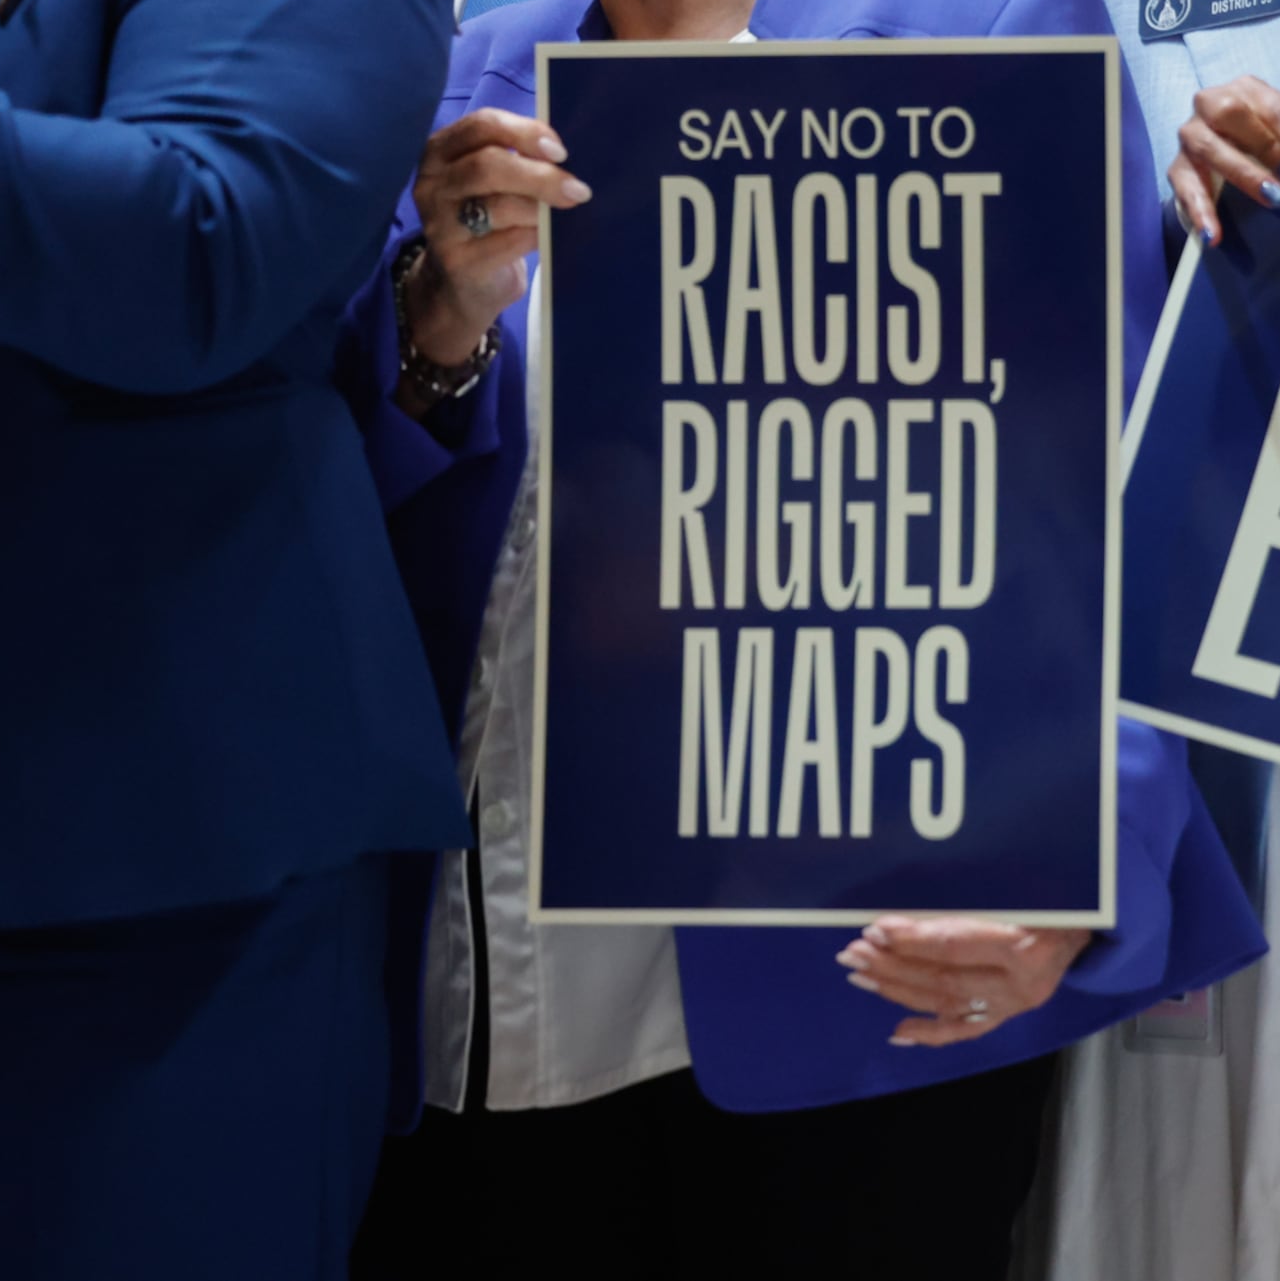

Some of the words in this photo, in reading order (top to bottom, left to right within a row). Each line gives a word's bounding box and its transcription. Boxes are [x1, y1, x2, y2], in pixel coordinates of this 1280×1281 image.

[679, 109, 786, 160] SAY
[802, 108, 884, 159] NO
[897, 107, 975, 158] TO
[660, 172, 1005, 403] RACIST,
[659, 398, 997, 611] RIGGED
[678, 625, 969, 840] MAPS
